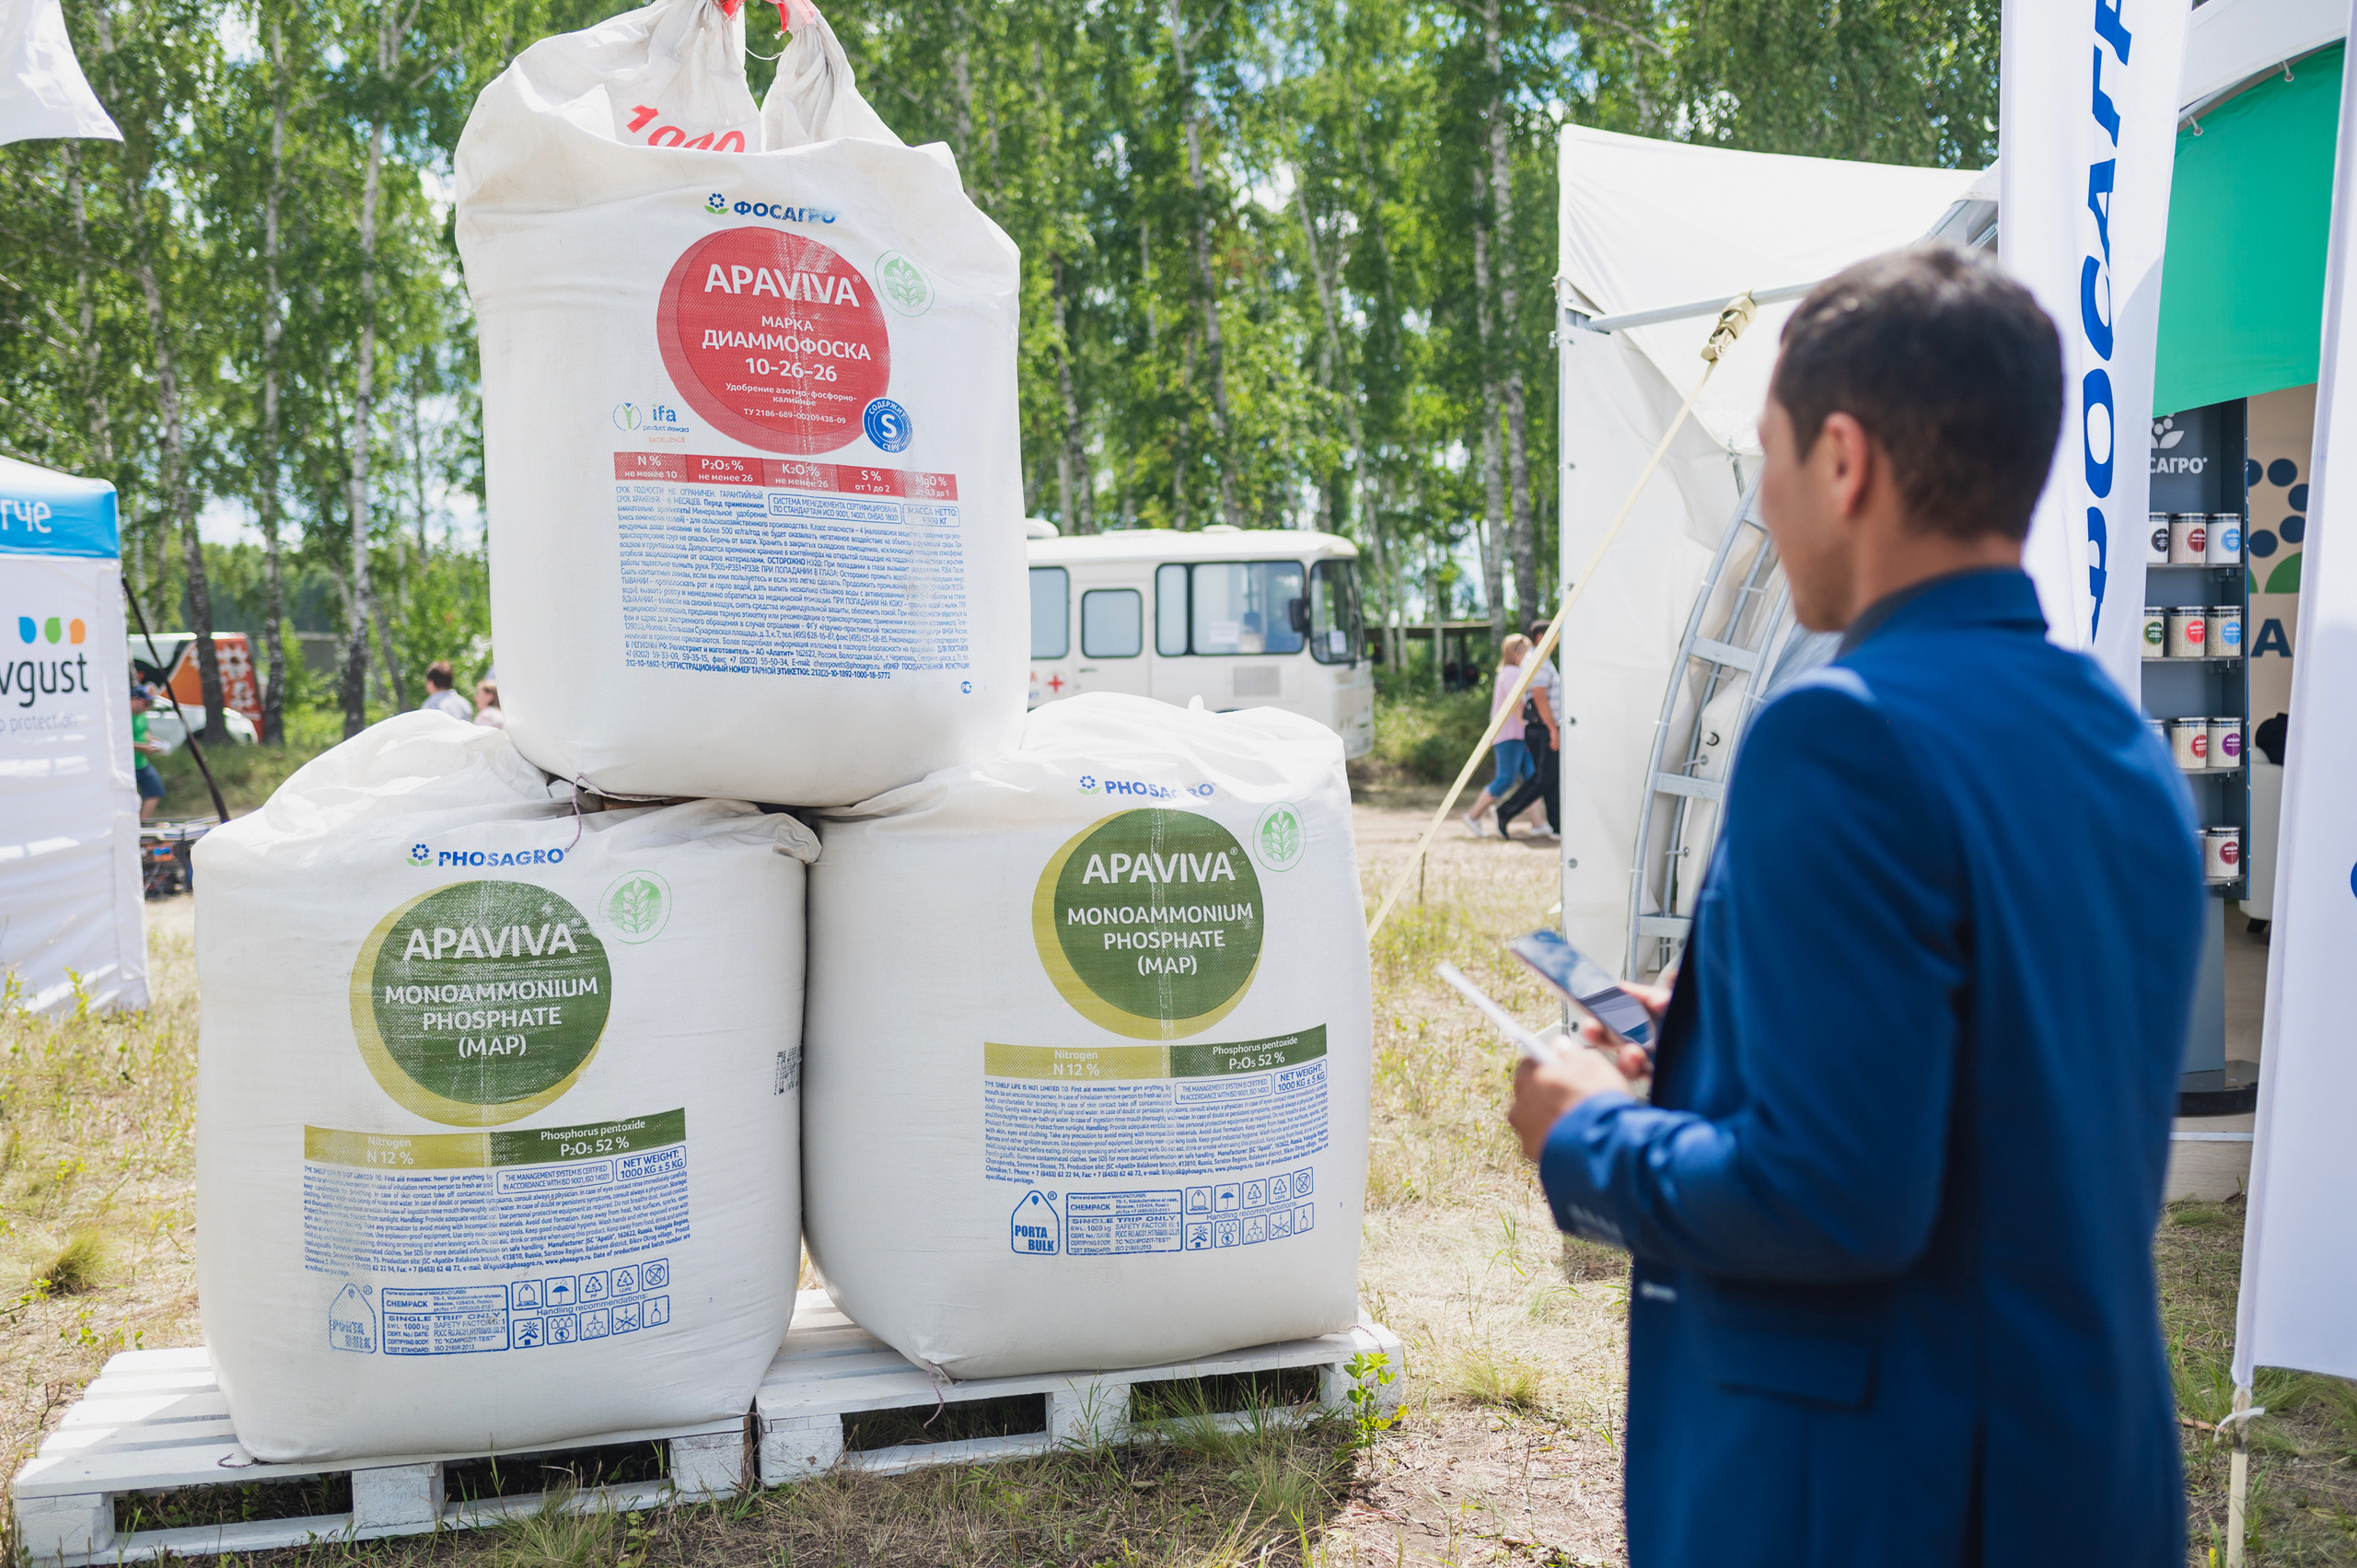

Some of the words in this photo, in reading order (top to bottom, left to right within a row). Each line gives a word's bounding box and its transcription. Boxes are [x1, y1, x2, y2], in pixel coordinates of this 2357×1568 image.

[704, 263, 860, 308] APAVIVA
[761, 315, 814, 332] МАРКА
[702, 328, 872, 361] ДИАММОФОСКА
[745, 356, 838, 383] 10-26-26
[726, 382, 774, 395] Удобрение
[772, 395, 817, 407] калийное
[652, 402, 677, 423] ifa
[743, 408, 755, 416] ТУ
[881, 413, 897, 438] S
[637, 455, 646, 466] N
[731, 460, 744, 471] %
[741, 474, 753, 482] 26
[787, 478, 818, 487] менее
[818, 480, 829, 488] 26
[861, 470, 868, 481] S
[870, 470, 882, 482] %
[937, 476, 947, 487] %
[885, 484, 890, 493] 2
[772, 496, 802, 505] СИСТЕМА
[801, 499, 845, 510] МЕНЕДЖМЕНТА
[783, 505, 822, 516] СТАНДАРТАМ
[935, 508, 958, 517] НЕТТО:
[667, 660, 728, 672] РЕГИСТРАЦИОННЫЙ
[728, 665, 750, 674] НОМЕР
[438, 847, 565, 866] PHOSAGRO
[1082, 851, 1236, 884] APAVIVA
[1067, 902, 1254, 926] MONOAMMONIUM
[402, 923, 579, 961] APAVIVA
[1104, 930, 1226, 950] PHOSPHATE
[1137, 956, 1198, 976] (MAP)
[385, 976, 598, 1005] MONOAMMONIUM
[423, 1006, 563, 1031] PHOSPHATE
[458, 1034, 528, 1059] (MAP)
[1213, 1041, 1261, 1056] Phosphorus
[1261, 1036, 1298, 1052] pentoxide
[1054, 1050, 1098, 1062] Nitrogen
[1258, 1054, 1272, 1066] 52
[1273, 1051, 1285, 1063] %
[1053, 1063, 1063, 1075] N
[1067, 1063, 1084, 1075] 12
[1086, 1063, 1100, 1076] %
[1280, 1073, 1295, 1082] NET
[1295, 1063, 1323, 1078] WEIGHT:
[1192, 1083, 1225, 1092] MANAGEMENT
[1225, 1082, 1243, 1090] SYSTEM
[1248, 1078, 1268, 1088] CERTIFIED
[1278, 1083, 1295, 1092] 1000
[1295, 1080, 1306, 1088] KG
[1317, 1073, 1326, 1083] KG
[1185, 1092, 1217, 1100] ACCORDANCE
[540, 1126, 599, 1141] Phosphorus
[600, 1120, 646, 1138] pentoxide
[368, 1136, 412, 1149] Nitrogen
[596, 1139, 613, 1153] 52
[615, 1136, 630, 1149] %
[367, 1153, 377, 1164] N
[379, 1153, 397, 1165] 12
[400, 1152, 414, 1165] %
[623, 1157, 642, 1168] NET
[643, 1151, 679, 1165] WEIGHT:
[505, 1174, 517, 1182] THE
[516, 1170, 556, 1182] MANAGEMENT
[555, 1168, 577, 1178] SYSTEM
[582, 1165, 608, 1176] CERTIFIED
[621, 1167, 643, 1179] 1000
[644, 1164, 656, 1175] KG
[664, 1162, 670, 1171] 5
[671, 1158, 683, 1169] KG
[508, 1179, 547, 1190] ACCORDANCE
[546, 1179, 562, 1188] WITH
[562, 1178, 571, 1186] ISO
[585, 1175, 594, 1183] ISO
[1206, 1211, 1238, 1221] Handling
[1238, 1201, 1299, 1217] recommendations:
[1015, 1225, 1048, 1238] PORTA
[1028, 1238, 1055, 1251] BULK
[386, 1299, 428, 1308] CHEMPACK
[537, 1306, 574, 1317] Handling
[575, 1293, 649, 1313] recommendations:
[434, 1320, 461, 1329] SAFETY
